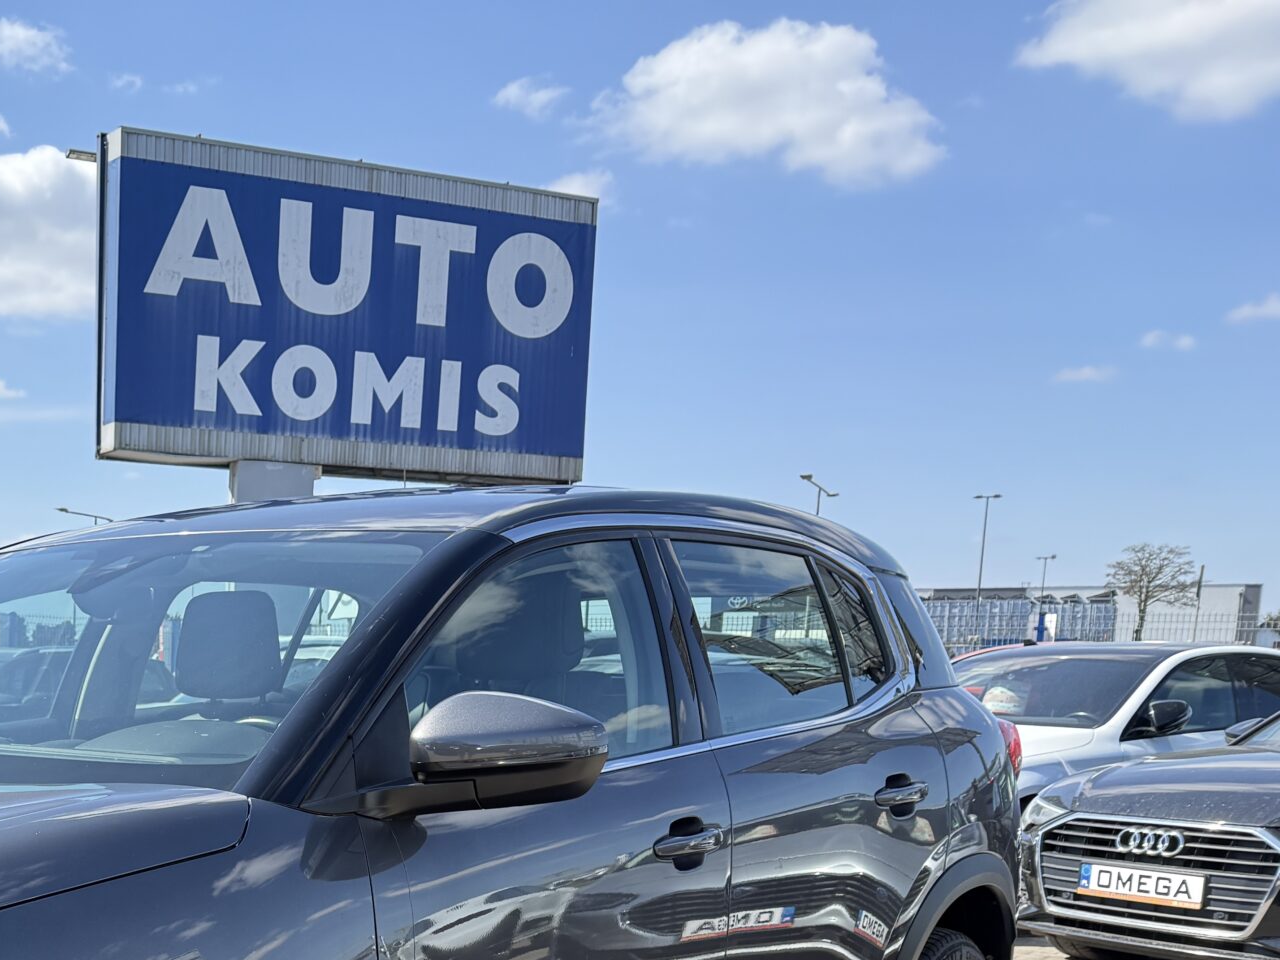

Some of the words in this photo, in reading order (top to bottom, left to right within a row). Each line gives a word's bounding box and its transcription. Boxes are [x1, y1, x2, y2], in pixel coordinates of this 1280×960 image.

[143, 185, 574, 339] AUTO
[193, 334, 520, 437] KOMIS
[1097, 869, 1192, 900] OMEGA
